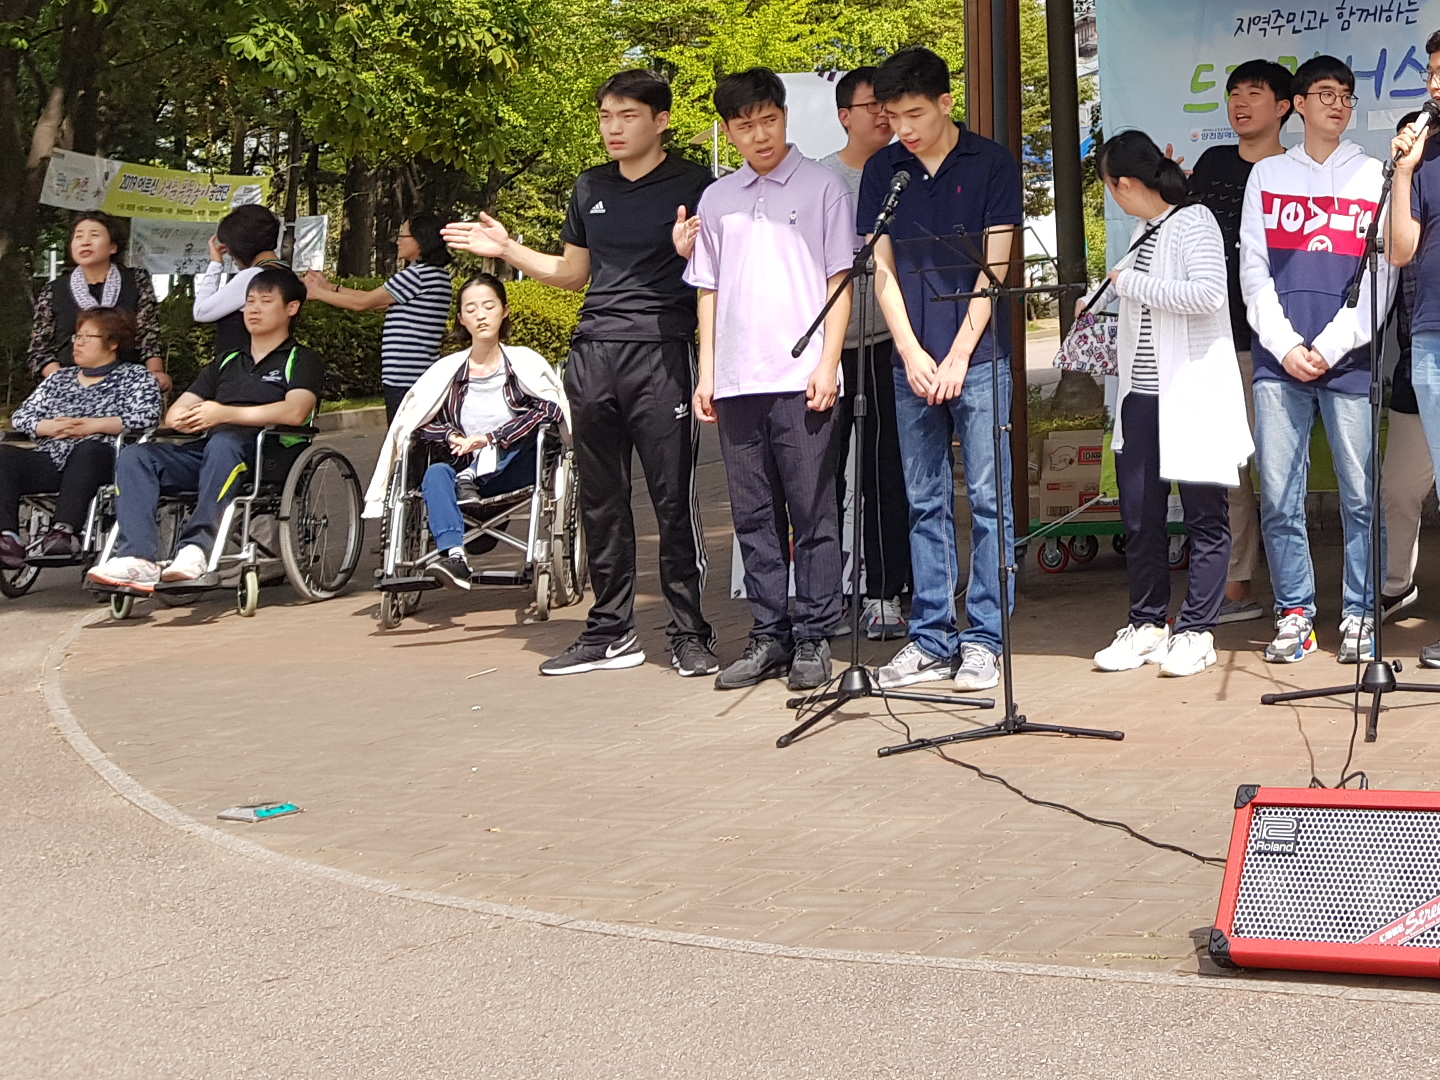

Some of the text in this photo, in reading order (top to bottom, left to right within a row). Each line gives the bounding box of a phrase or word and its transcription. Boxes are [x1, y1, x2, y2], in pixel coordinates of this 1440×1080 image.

[1234, 8, 1329, 37] 지역주민과
[119, 174, 138, 191] 2019
[137, 176, 160, 196] 어르신
[1256, 841, 1294, 852] Roland
